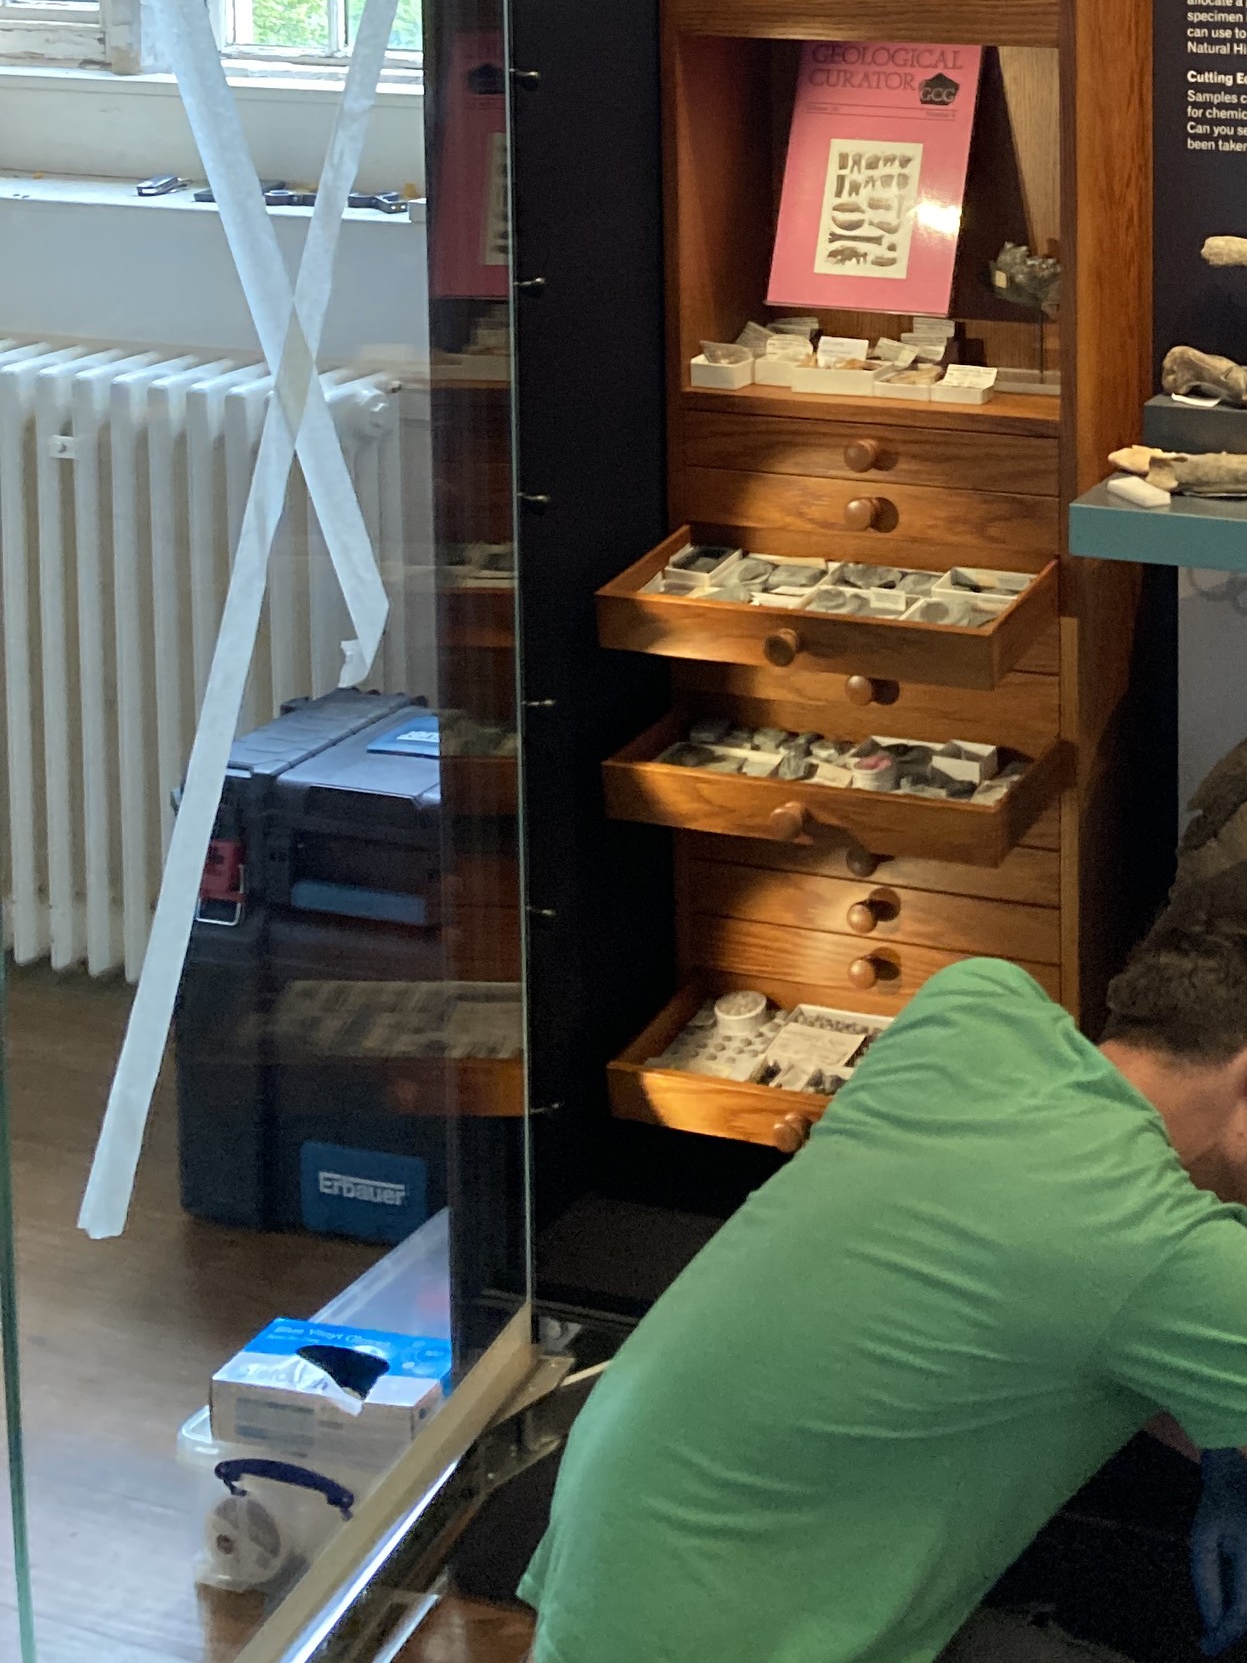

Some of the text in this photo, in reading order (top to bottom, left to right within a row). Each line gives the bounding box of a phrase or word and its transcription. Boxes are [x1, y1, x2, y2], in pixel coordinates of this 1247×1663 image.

[813, 44, 963, 70] GEOLOGICAL
[808, 68, 917, 91] CURATOR
[1186, 69, 1233, 87] Cutting
[1186, 88, 1238, 106] Samples
[1186, 104, 1204, 118] for
[1185, 120, 1211, 134] Can
[1212, 124, 1235, 138] you
[1186, 136, 1216, 150] been
[319, 1170, 405, 1206] Erbauer
